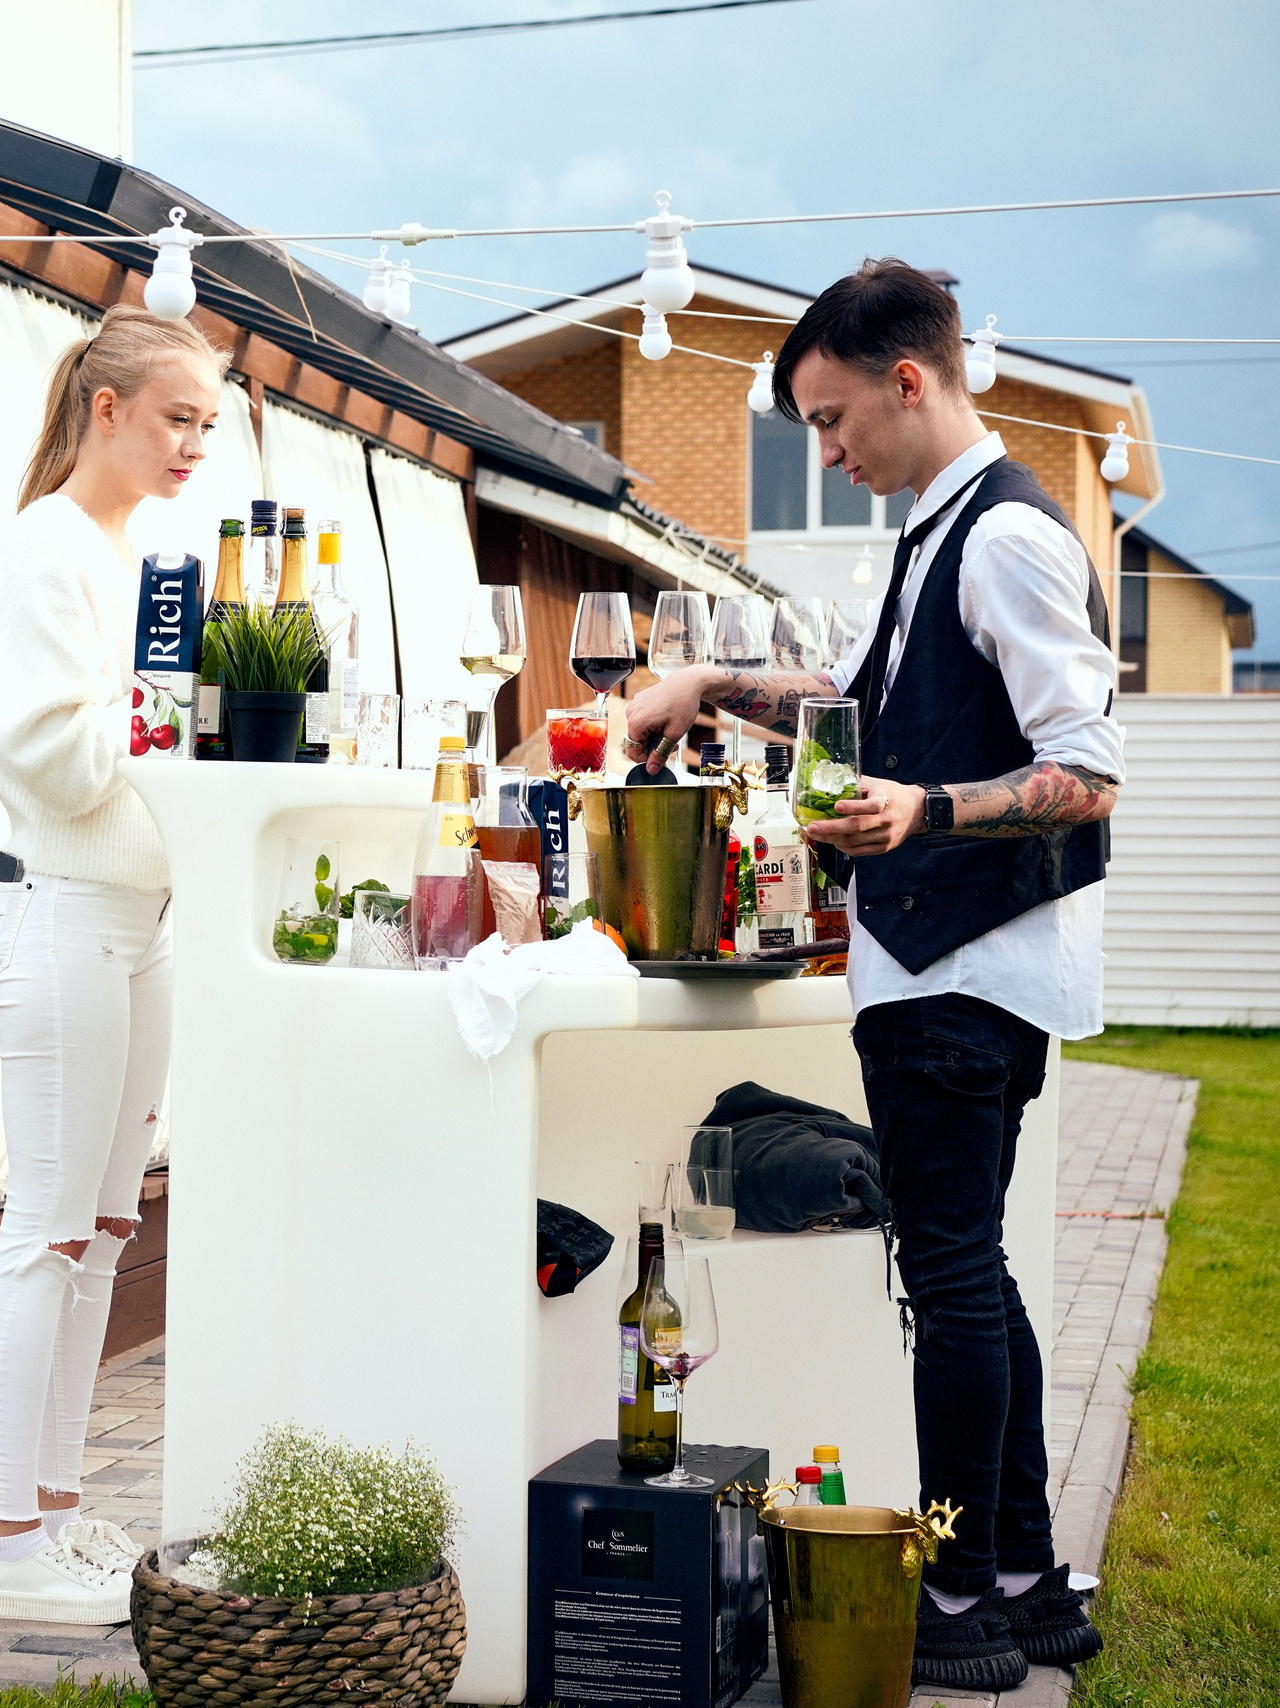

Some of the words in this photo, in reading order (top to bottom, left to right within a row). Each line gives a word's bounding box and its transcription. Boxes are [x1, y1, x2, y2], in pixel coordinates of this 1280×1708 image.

[147, 579, 183, 665] Rich
[587, 1540, 605, 1549] Chef
[609, 1541, 648, 1553] Sommelier
